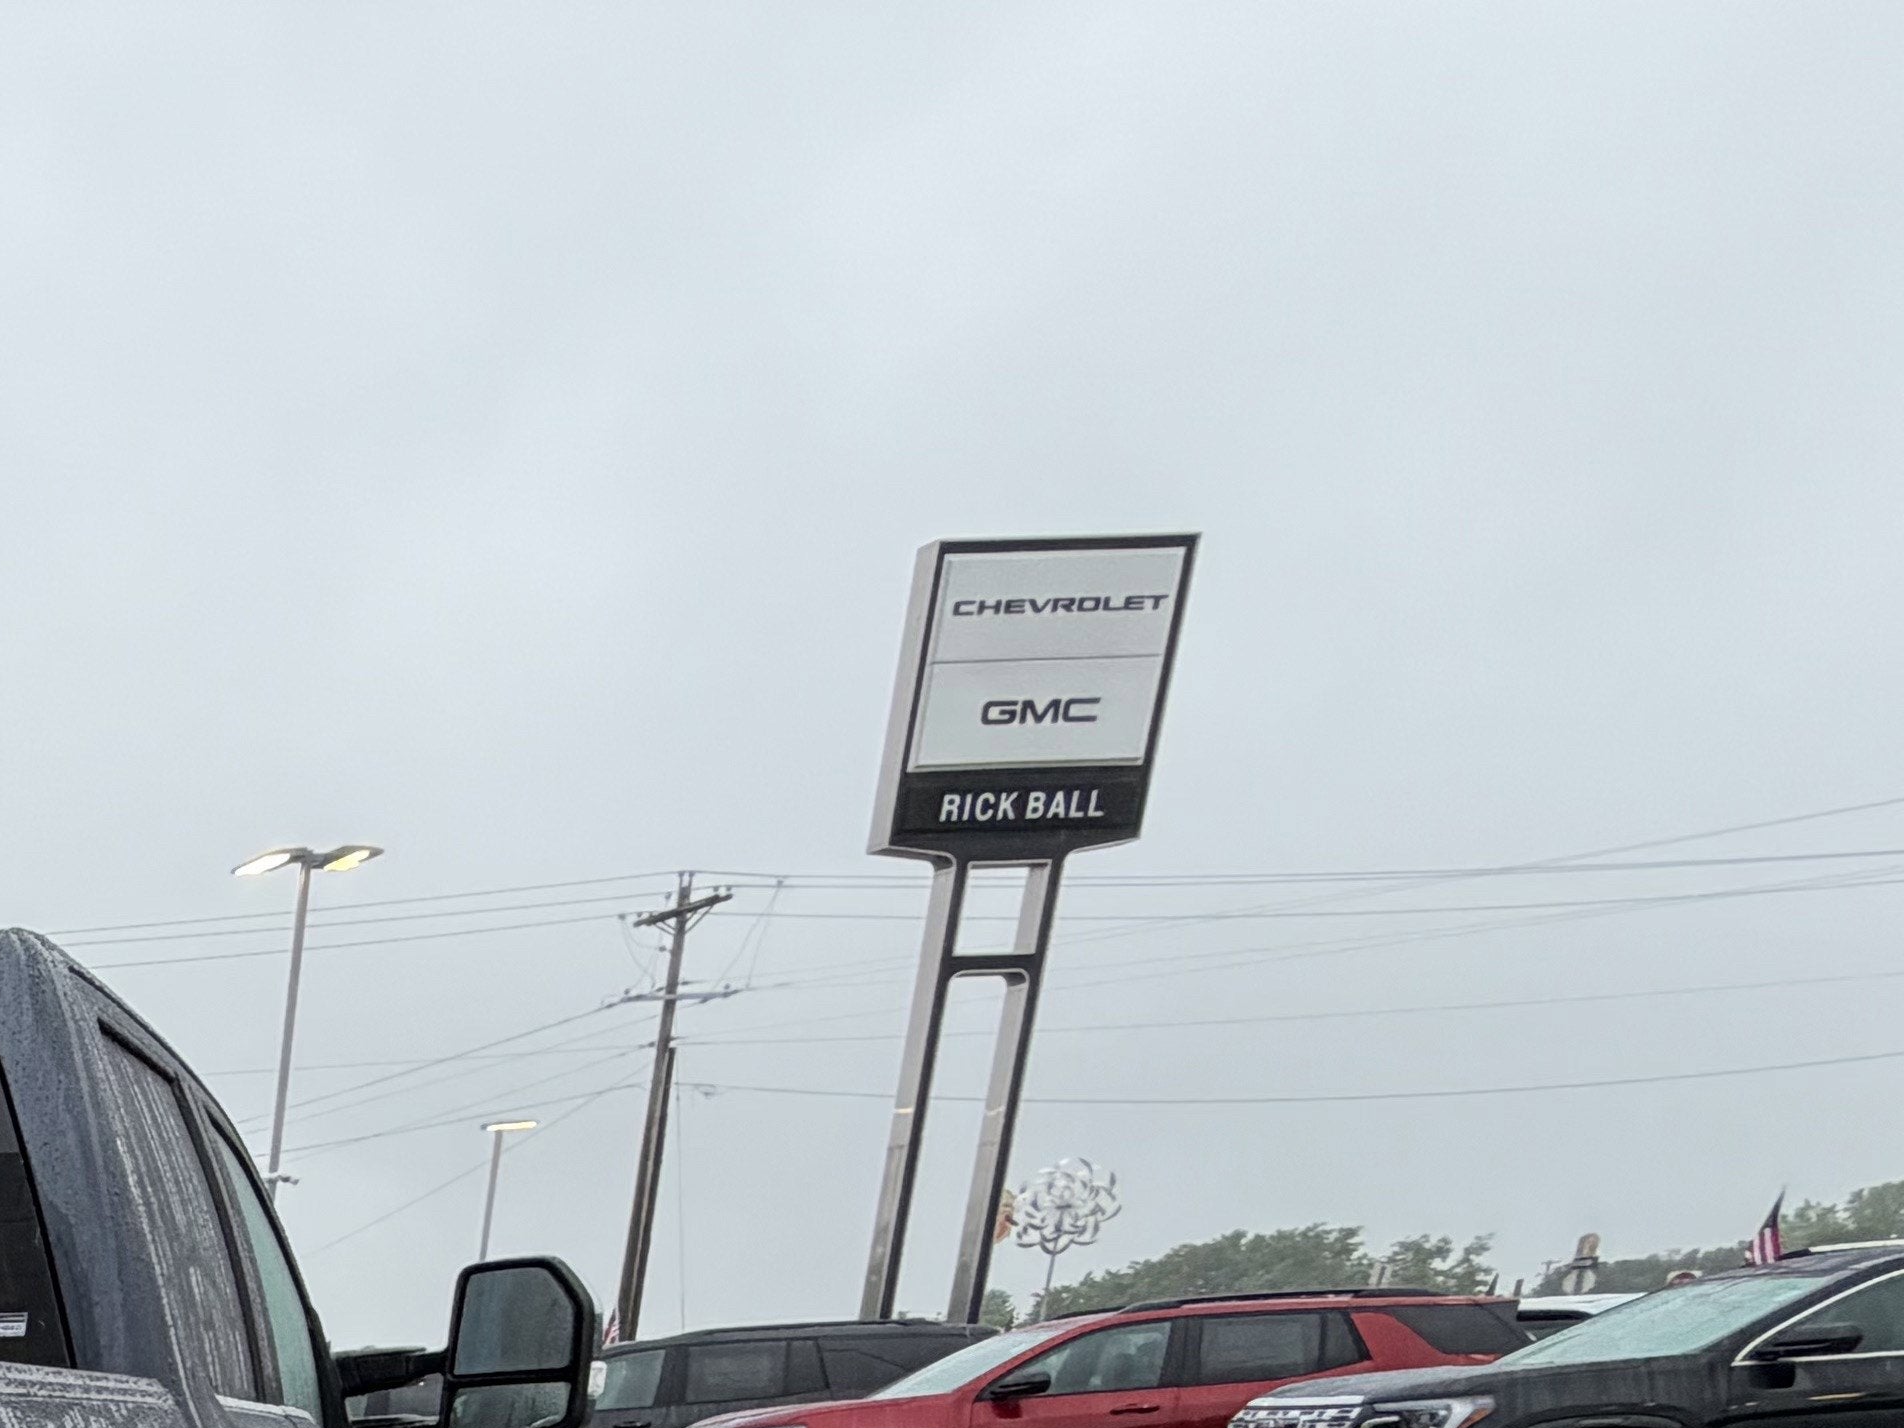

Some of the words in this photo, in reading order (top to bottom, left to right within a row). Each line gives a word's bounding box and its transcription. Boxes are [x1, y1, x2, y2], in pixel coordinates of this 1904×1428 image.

[952, 594, 1169, 617] CHEVROLET
[980, 697, 1101, 725] GMC
[938, 791, 1019, 823] RICK
[1024, 788, 1106, 819] BALL
